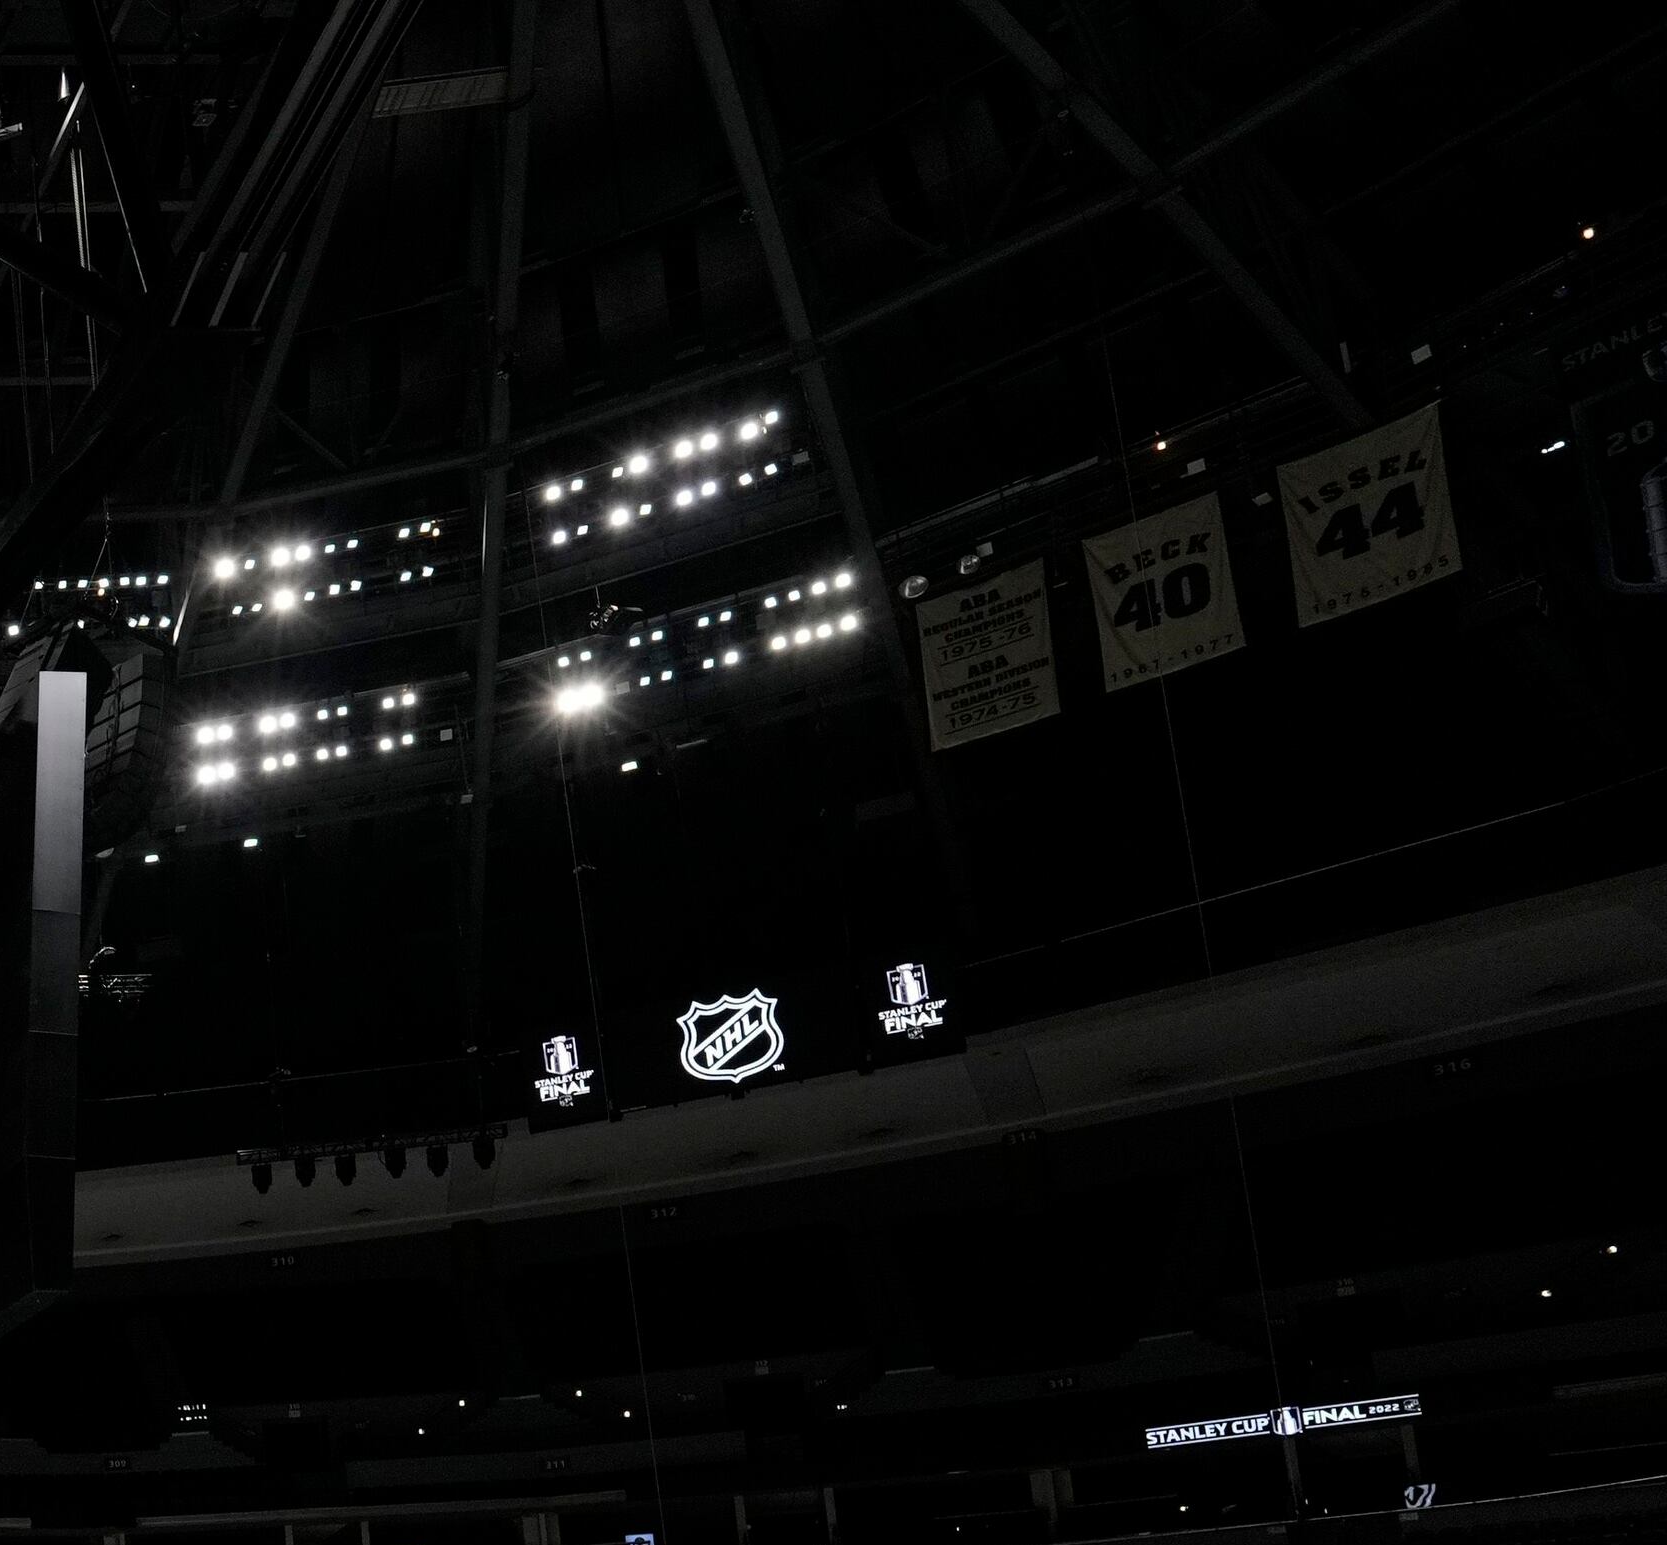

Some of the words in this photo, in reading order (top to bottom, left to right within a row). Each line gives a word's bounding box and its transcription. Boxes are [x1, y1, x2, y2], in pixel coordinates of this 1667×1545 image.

[1296, 449, 1430, 516] ISSEL
[1317, 481, 1425, 561] 44
[1104, 532, 1212, 584] BECK
[1113, 562, 1212, 632] 40
[877, 1004, 923, 1020] STANLEY
[924, 999, 945, 1011] CUP
[884, 1009, 943, 1033] FINAL
[703, 1012, 760, 1068] NHL
[534, 1074, 573, 1088] STANLEY
[574, 1069, 593, 1080] CUP
[540, 1079, 590, 1101] FINAL
[1146, 1424, 1227, 1446] STANLEY
[1232, 1418, 1269, 1434] CUP
[1302, 1405, 1367, 1427] FINAL
[1368, 1403, 1400, 1414] 2022
